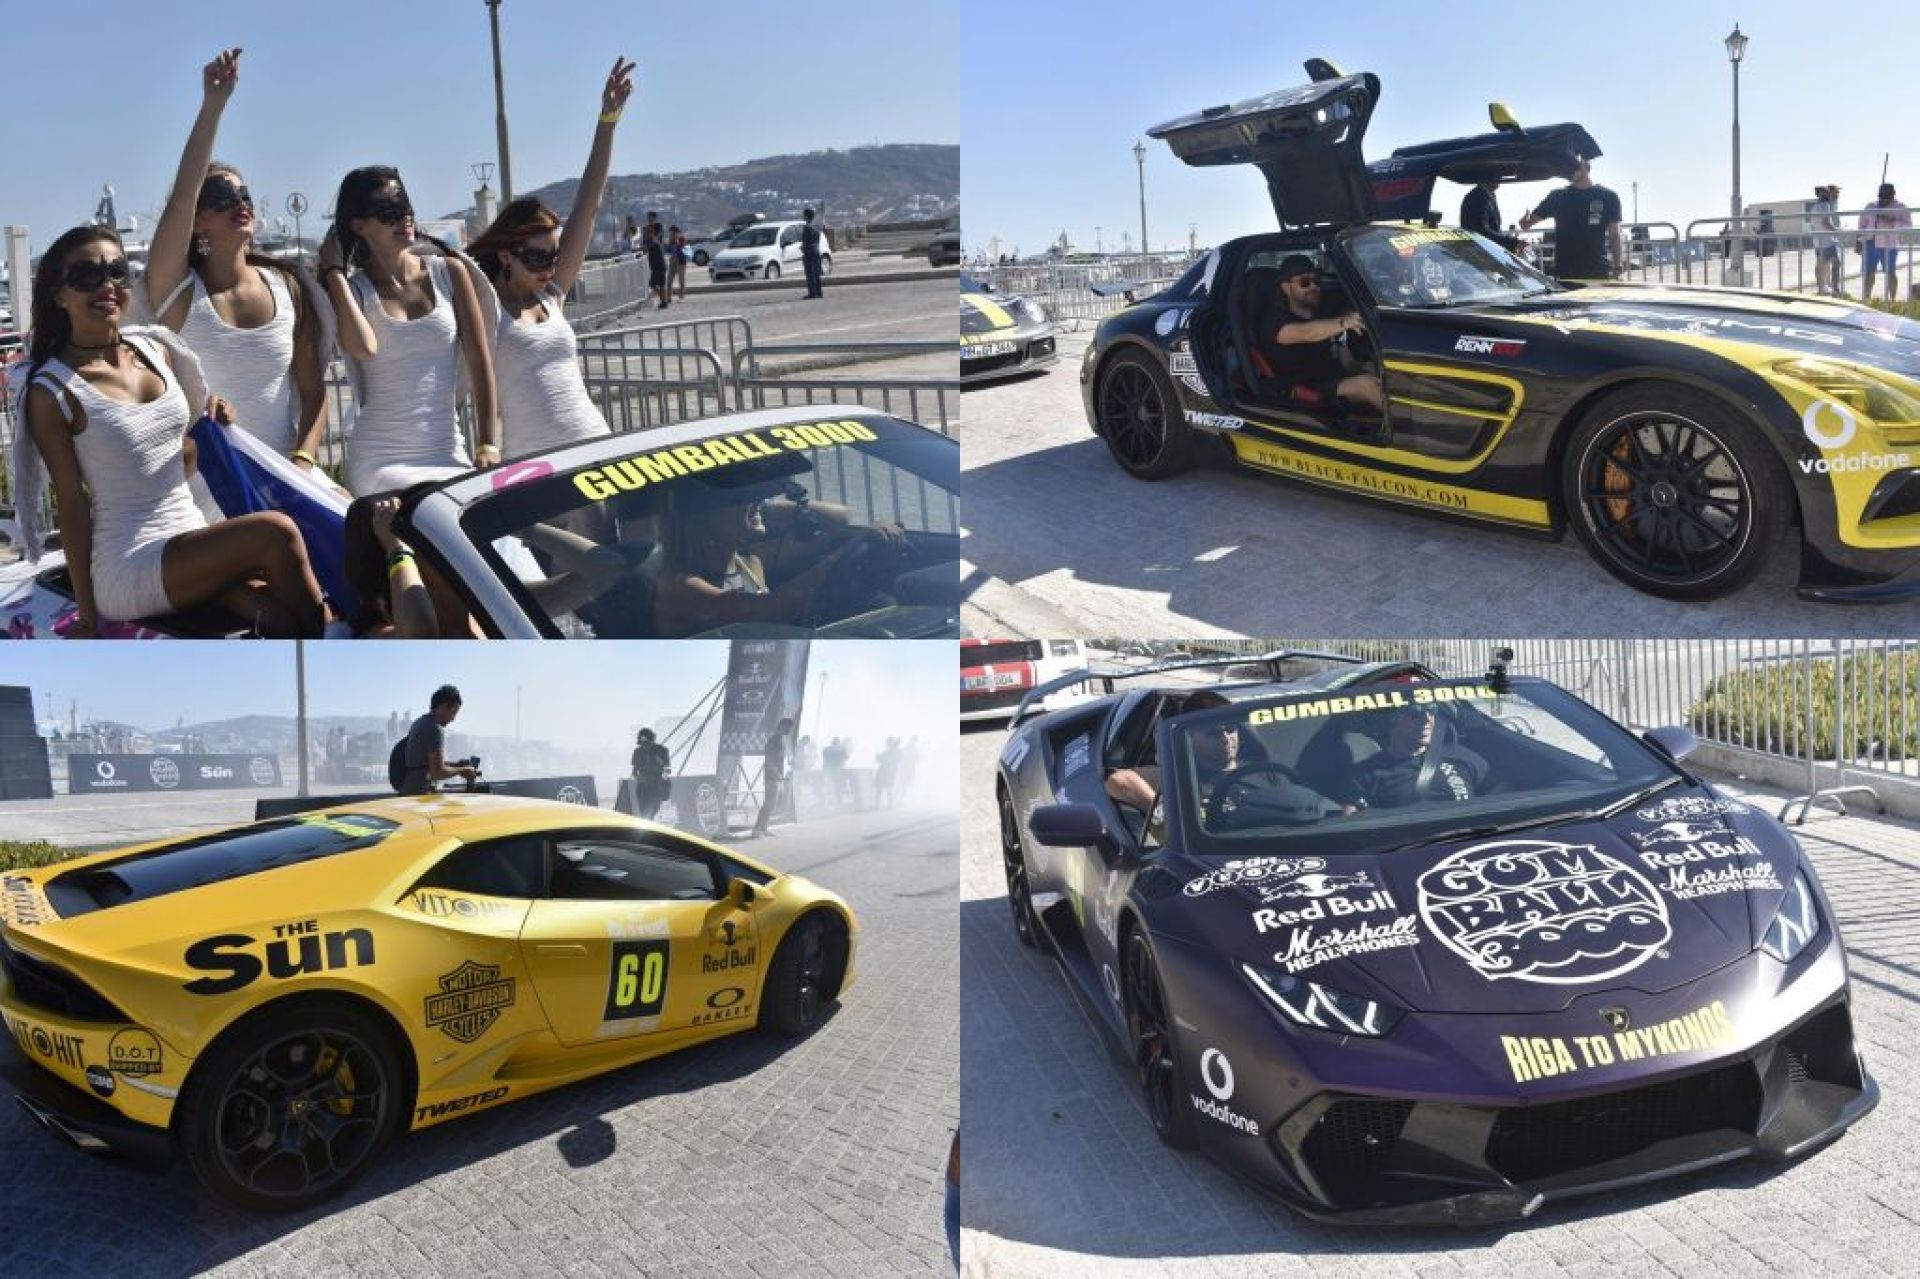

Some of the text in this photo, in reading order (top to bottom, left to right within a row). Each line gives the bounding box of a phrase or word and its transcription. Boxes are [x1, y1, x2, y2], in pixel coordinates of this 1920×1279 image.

[572, 421, 879, 501] GUMBALL 3000
[1258, 450, 1468, 508] WWW.BLACK-FALCON.COM
[1798, 451, 1910, 474] vodafone
[1249, 685, 1497, 726] GUMBALL 3000
[1639, 836, 1764, 870] Red Bull
[1659, 862, 1777, 891] Marshall
[272, 919, 319, 938] THE
[1252, 890, 1396, 933] Red Bull
[1273, 914, 1417, 963] Marshall
[182, 928, 376, 995] Sun
[615, 952, 663, 1006] 60
[703, 947, 756, 973] Red Bull
[1500, 1000, 1731, 1082] RIGA TO MYKONOS
[1190, 1093, 1259, 1135] vodafone
